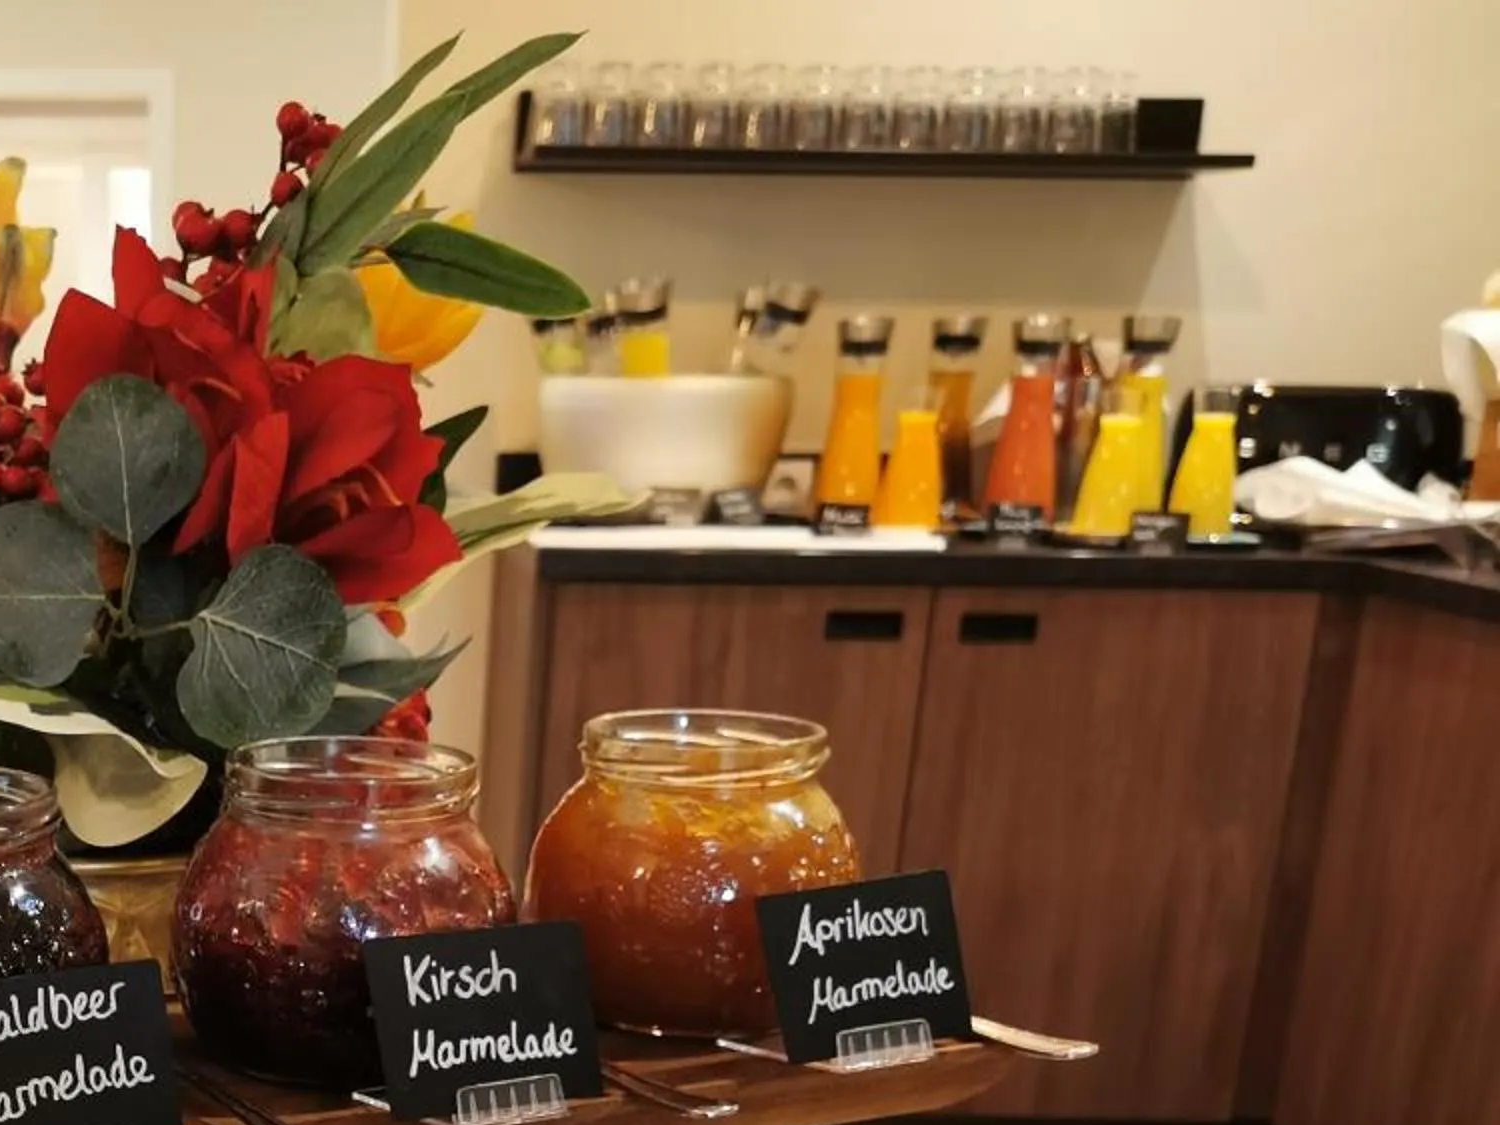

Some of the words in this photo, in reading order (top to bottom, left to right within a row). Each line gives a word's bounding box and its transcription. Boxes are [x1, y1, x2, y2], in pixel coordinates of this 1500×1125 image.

[788, 899, 930, 966] Aprikosen
[403, 949, 518, 1007] Kirsch
[808, 957, 955, 1025] Marmelade
[409, 1019, 578, 1079] Marmelade
